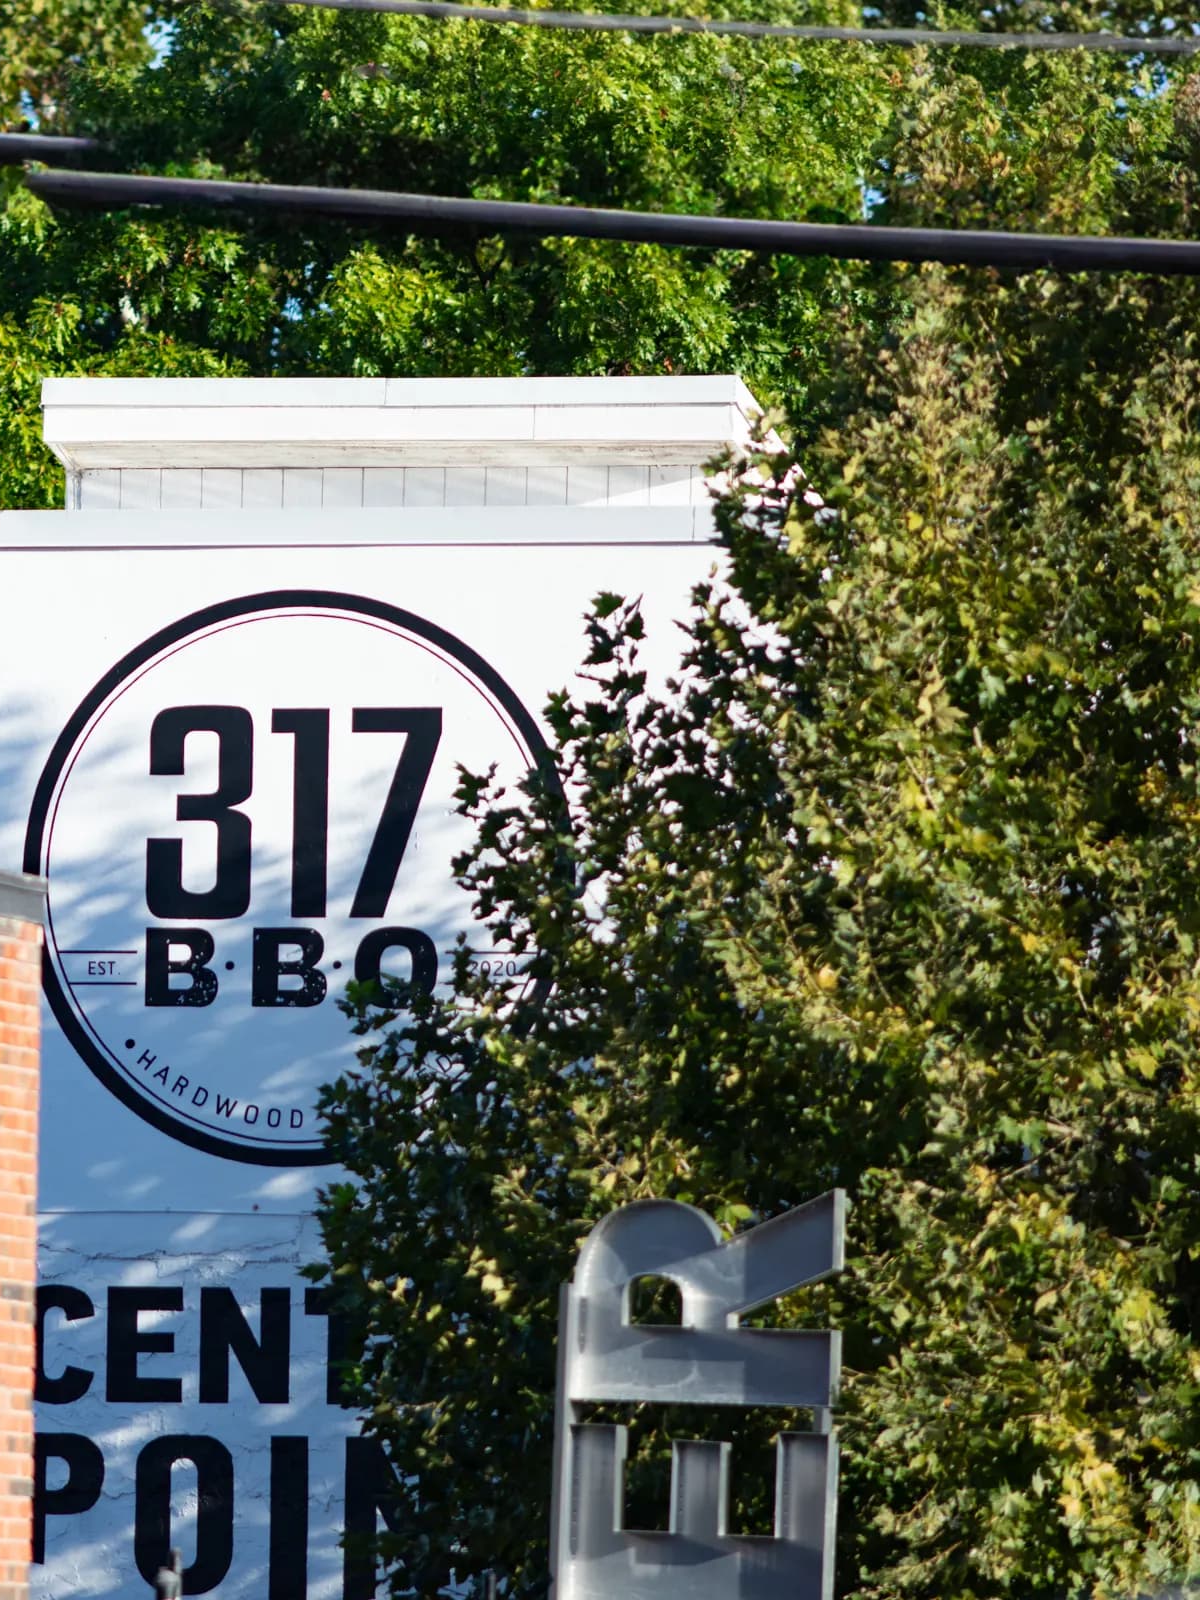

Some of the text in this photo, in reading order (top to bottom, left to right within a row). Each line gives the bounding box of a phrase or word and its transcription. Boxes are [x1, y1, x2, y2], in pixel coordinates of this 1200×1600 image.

[146, 705, 442, 920] 317
[88, 960, 121, 976] EST.
[469, 960, 517, 977] 2020
[137, 1049, 304, 1129] HARDWOOD
